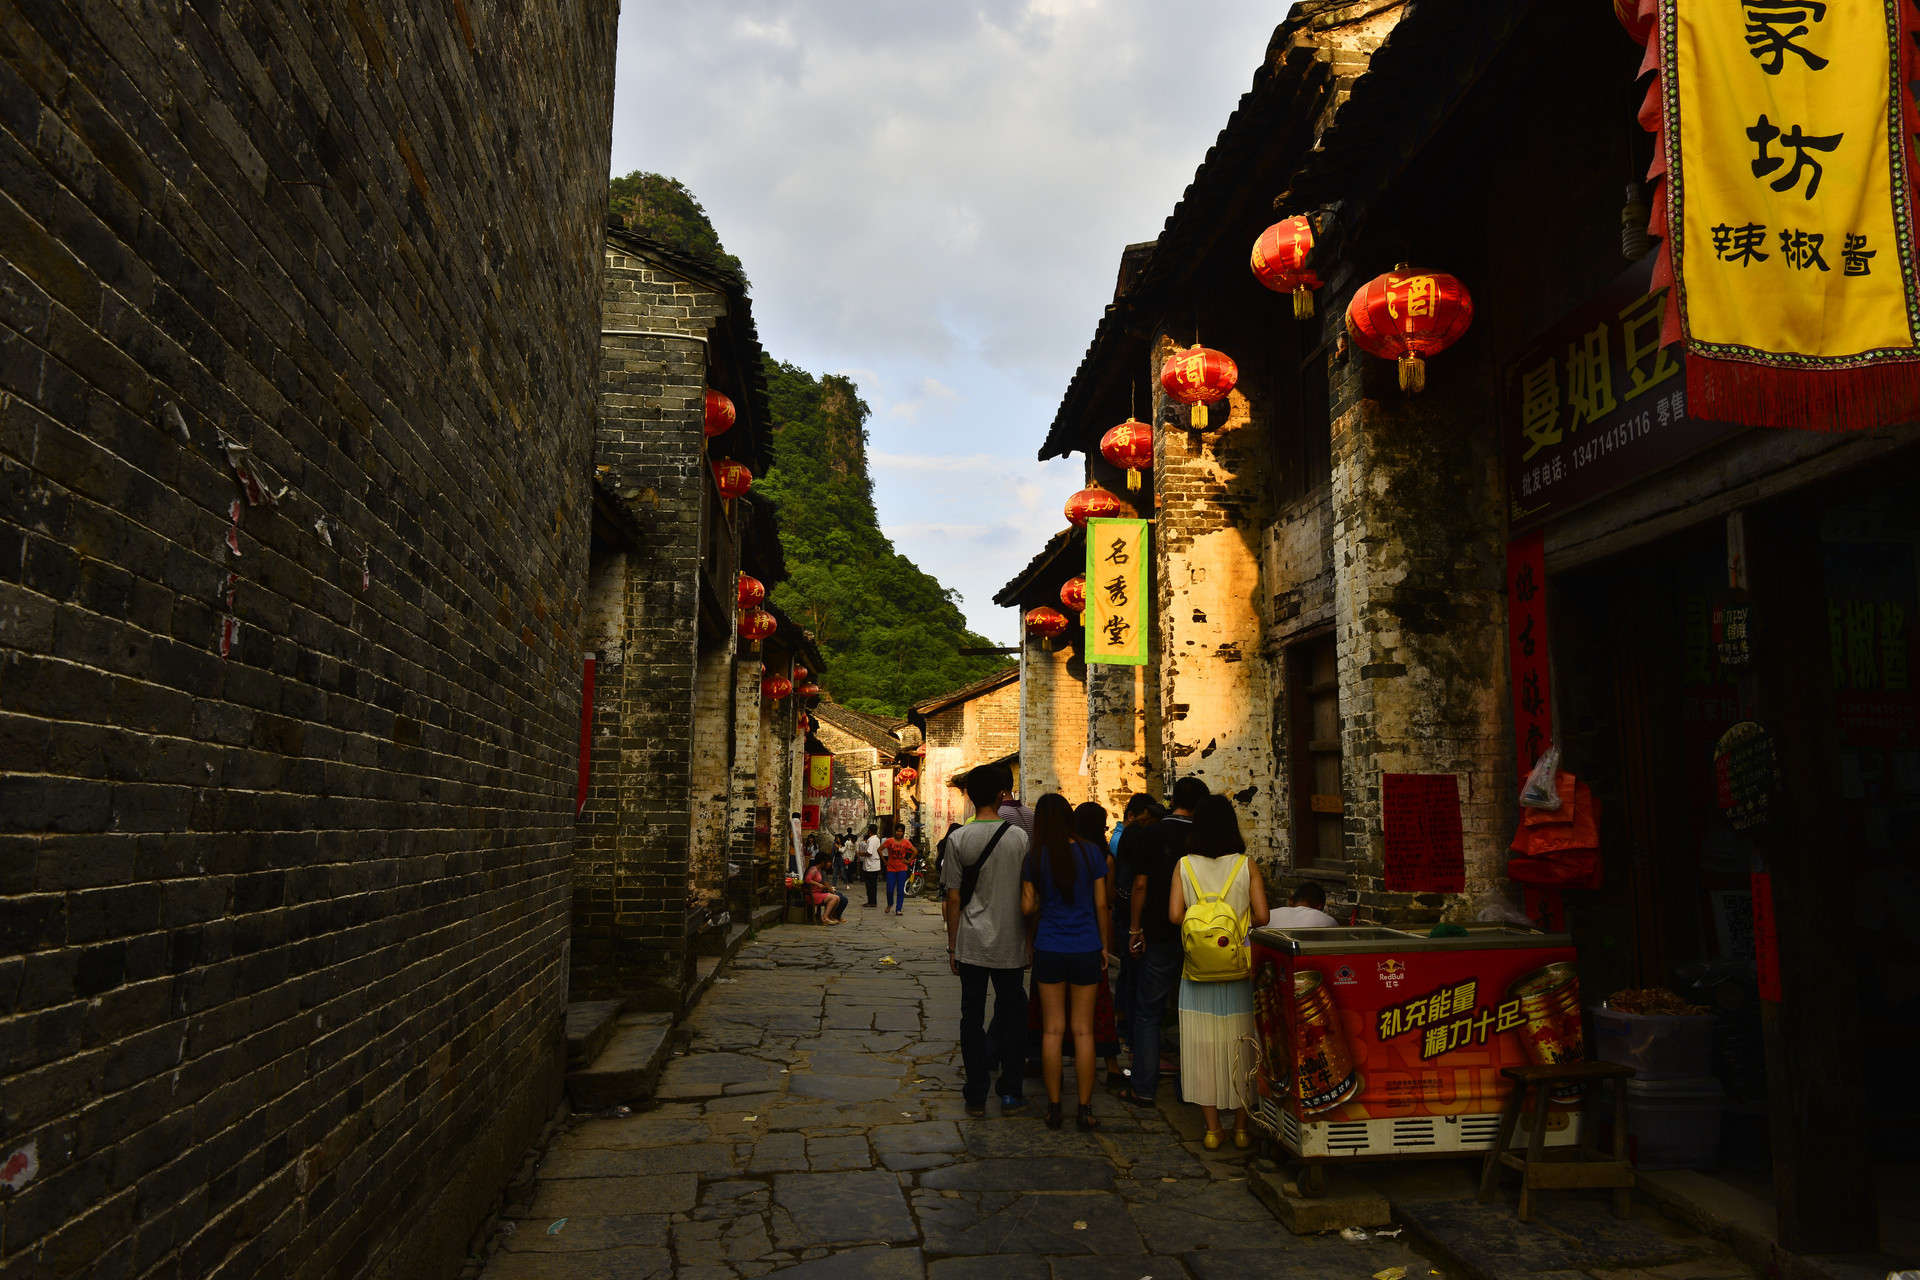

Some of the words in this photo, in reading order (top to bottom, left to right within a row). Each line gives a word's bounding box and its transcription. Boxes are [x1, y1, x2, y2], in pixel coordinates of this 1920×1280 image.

[1711, 222, 1877, 277] 辣椒酱
[1387, 273, 1436, 320] 酒
[1175, 352, 1206, 385] 酒
[1106, 425, 1137, 453] 黄
[1572, 410, 1651, 470] 13471415116
[1103, 537, 1131, 646] 名秀堂
[1385, 980, 1400, 988] 红牛
[1380, 981, 1477, 1040] 补充能量
[1424, 1000, 1528, 1059] 精力十足
[1299, 1050, 1328, 1077] edBull
